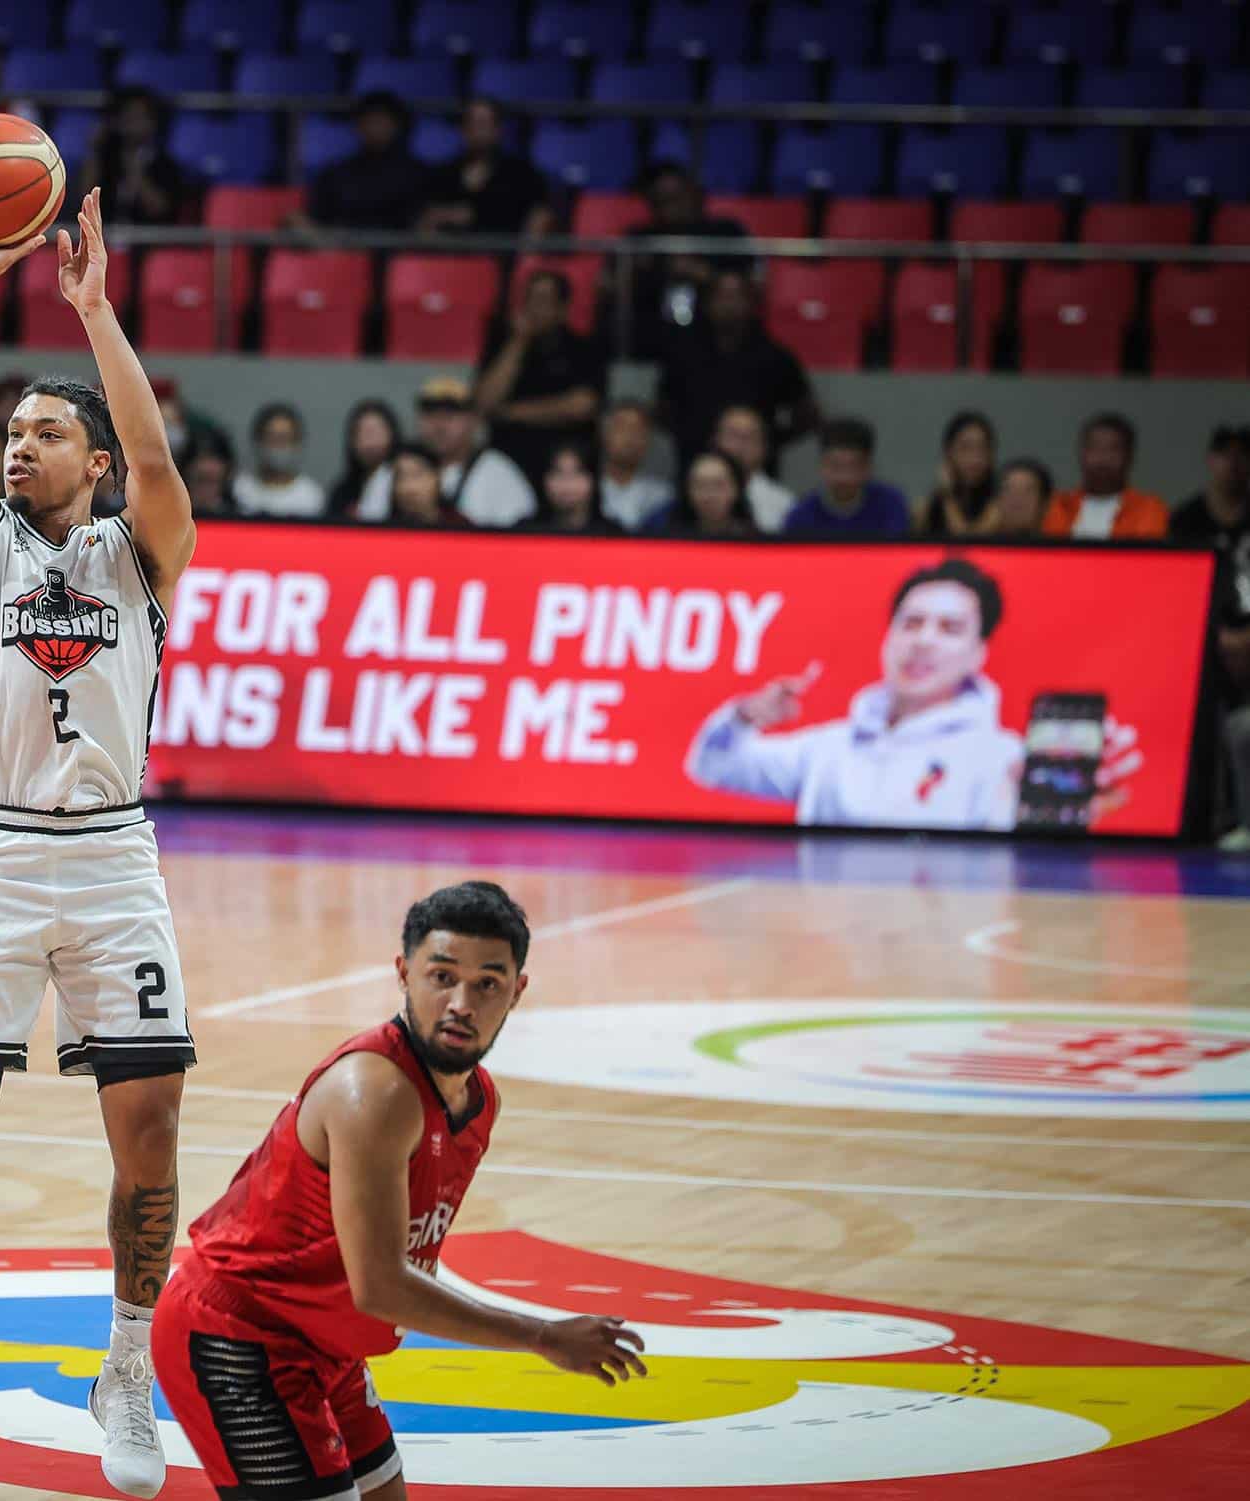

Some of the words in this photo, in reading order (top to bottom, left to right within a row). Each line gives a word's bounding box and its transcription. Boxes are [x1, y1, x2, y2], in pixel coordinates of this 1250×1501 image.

[3, 605, 117, 641] BOSSING
[168, 568, 330, 657] FOR
[343, 575, 507, 664] ALL
[528, 583, 784, 675] PINOY
[48, 689, 80, 743] 2
[150, 662, 284, 749] NS
[296, 667, 486, 758] LIKE
[499, 676, 638, 765] ME.
[135, 962, 169, 1019] 2
